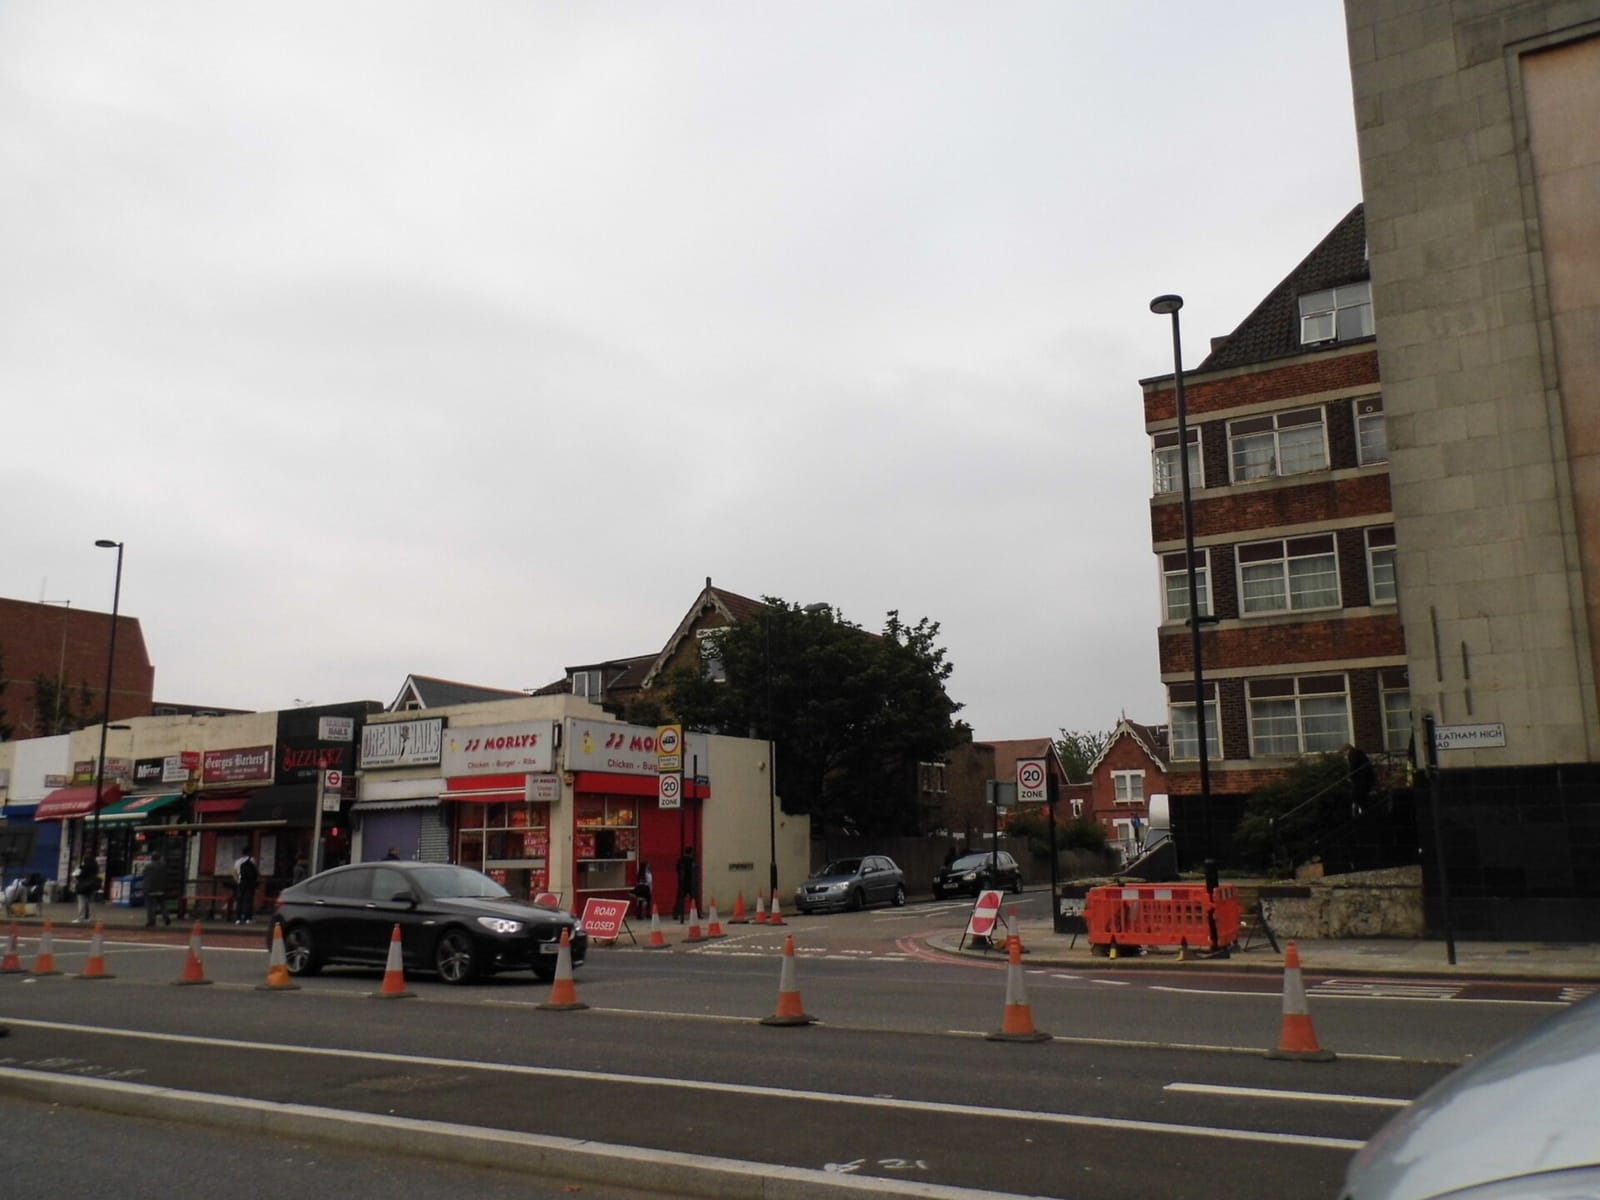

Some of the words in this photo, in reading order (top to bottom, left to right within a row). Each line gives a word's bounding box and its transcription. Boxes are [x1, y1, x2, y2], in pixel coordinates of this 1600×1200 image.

[1480, 729, 1502, 738] HIGH
[464, 738, 480, 752] JJ
[484, 734, 537, 750] MORLYS
[605, 732, 625, 750] JJ
[467, 760, 490, 769] Chicken
[496, 759, 516, 769] Burger
[607, 759, 634, 769] Chicken
[643, 761, 658, 773] Burg
[1023, 770, 1040, 781] 20
[664, 782, 676, 792] 20
[1022, 790, 1043, 798] ZONE
[594, 906, 616, 916] ROAD
[585, 920, 615, 931] CLOSED
